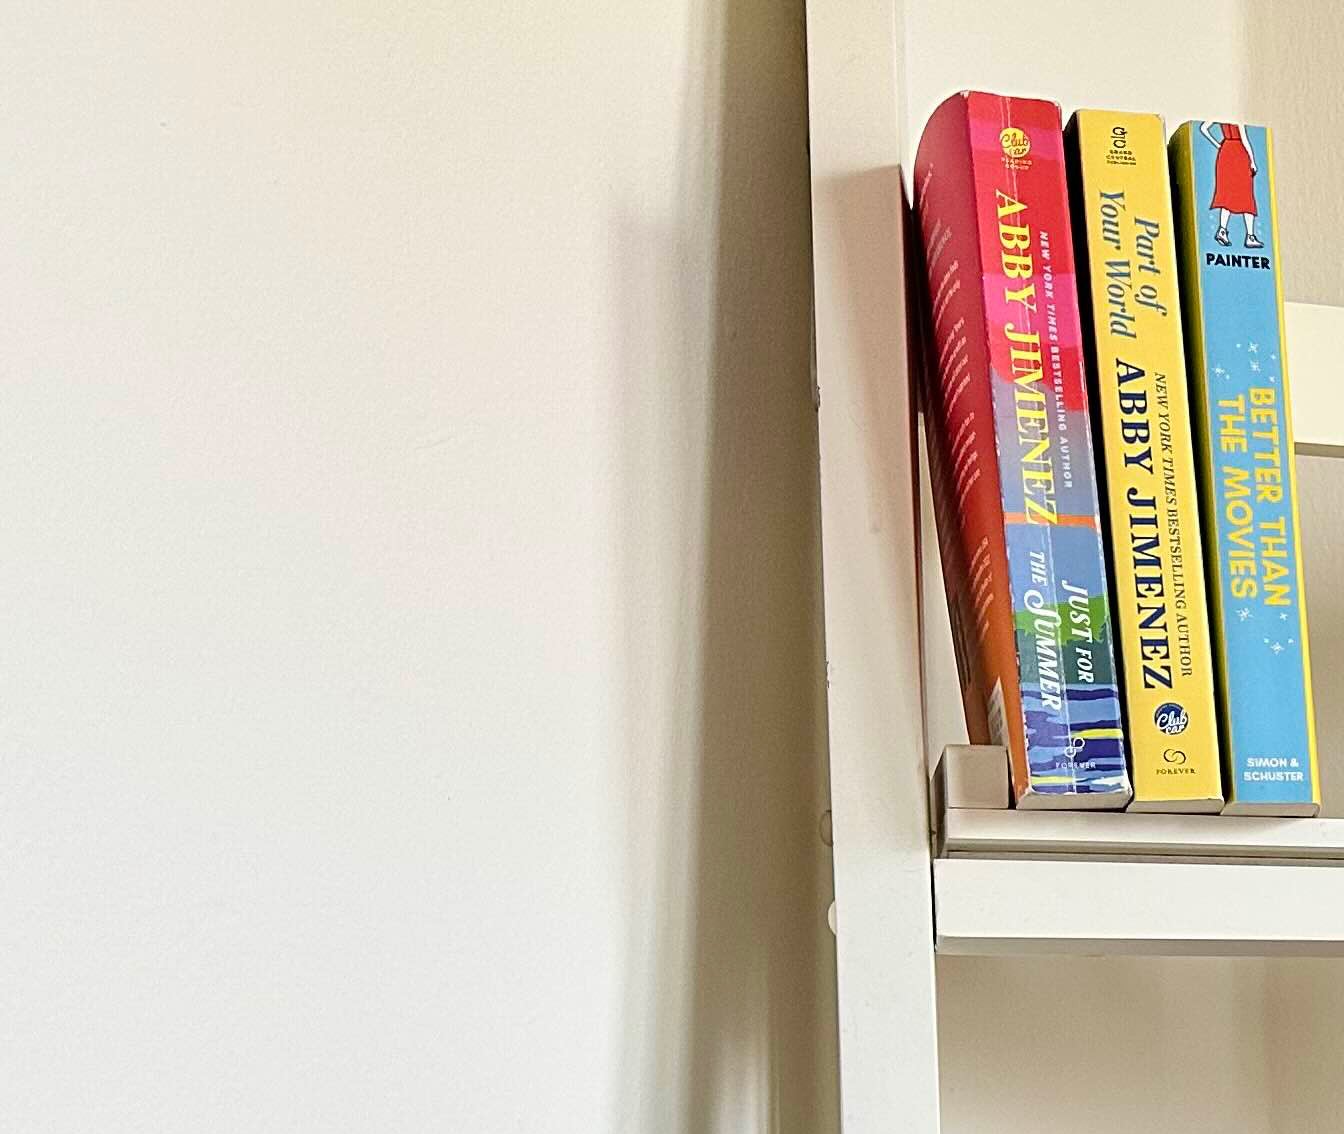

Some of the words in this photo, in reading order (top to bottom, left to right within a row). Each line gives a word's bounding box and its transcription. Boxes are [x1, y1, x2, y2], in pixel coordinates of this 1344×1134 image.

[1039, 231, 1050, 260] NEW
[1099, 191, 1125, 250] Your
[1134, 217, 1160, 275] Part
[996, 189, 1037, 312] ABBY
[1206, 253, 1271, 270] PAINTER
[1043, 264, 1054, 300] YORK
[1103, 258, 1137, 339] World
[1135, 283, 1167, 317] of
[1047, 303, 1058, 343] TIMES
[1050, 345, 1067, 432] BESTSELLING
[1115, 357, 1153, 475] ABBY
[1154, 372, 1170, 409] NEW
[1004, 324, 1059, 525] JIMENEZ
[1158, 411, 1174, 455] YORK
[1216, 394, 1248, 453] THE
[1248, 387, 1282, 502] BETTER
[1060, 437, 1072, 489] AUTHOR
[1162, 455, 1178, 506] TIMES
[1167, 508, 1185, 611] BESTSELLING
[1222, 467, 1258, 600] MOVIES
[1259, 517, 1292, 608] THAN
[1027, 551, 1046, 586] THE
[1124, 488, 1173, 689] JIMENEZ
[1062, 581, 1091, 643] JUST
[1024, 588, 1064, 711] SUMMER
[1076, 648, 1093, 683] FOR
[1176, 615, 1193, 677] AUTHOR
[1157, 711, 1188, 729] Club
[1156, 767, 1196, 776] FOREVER
[1243, 770, 1304, 782] SCHUSTER
[1246, 757, 1281, 768] SIMON
[1288, 758, 1299, 768] &
